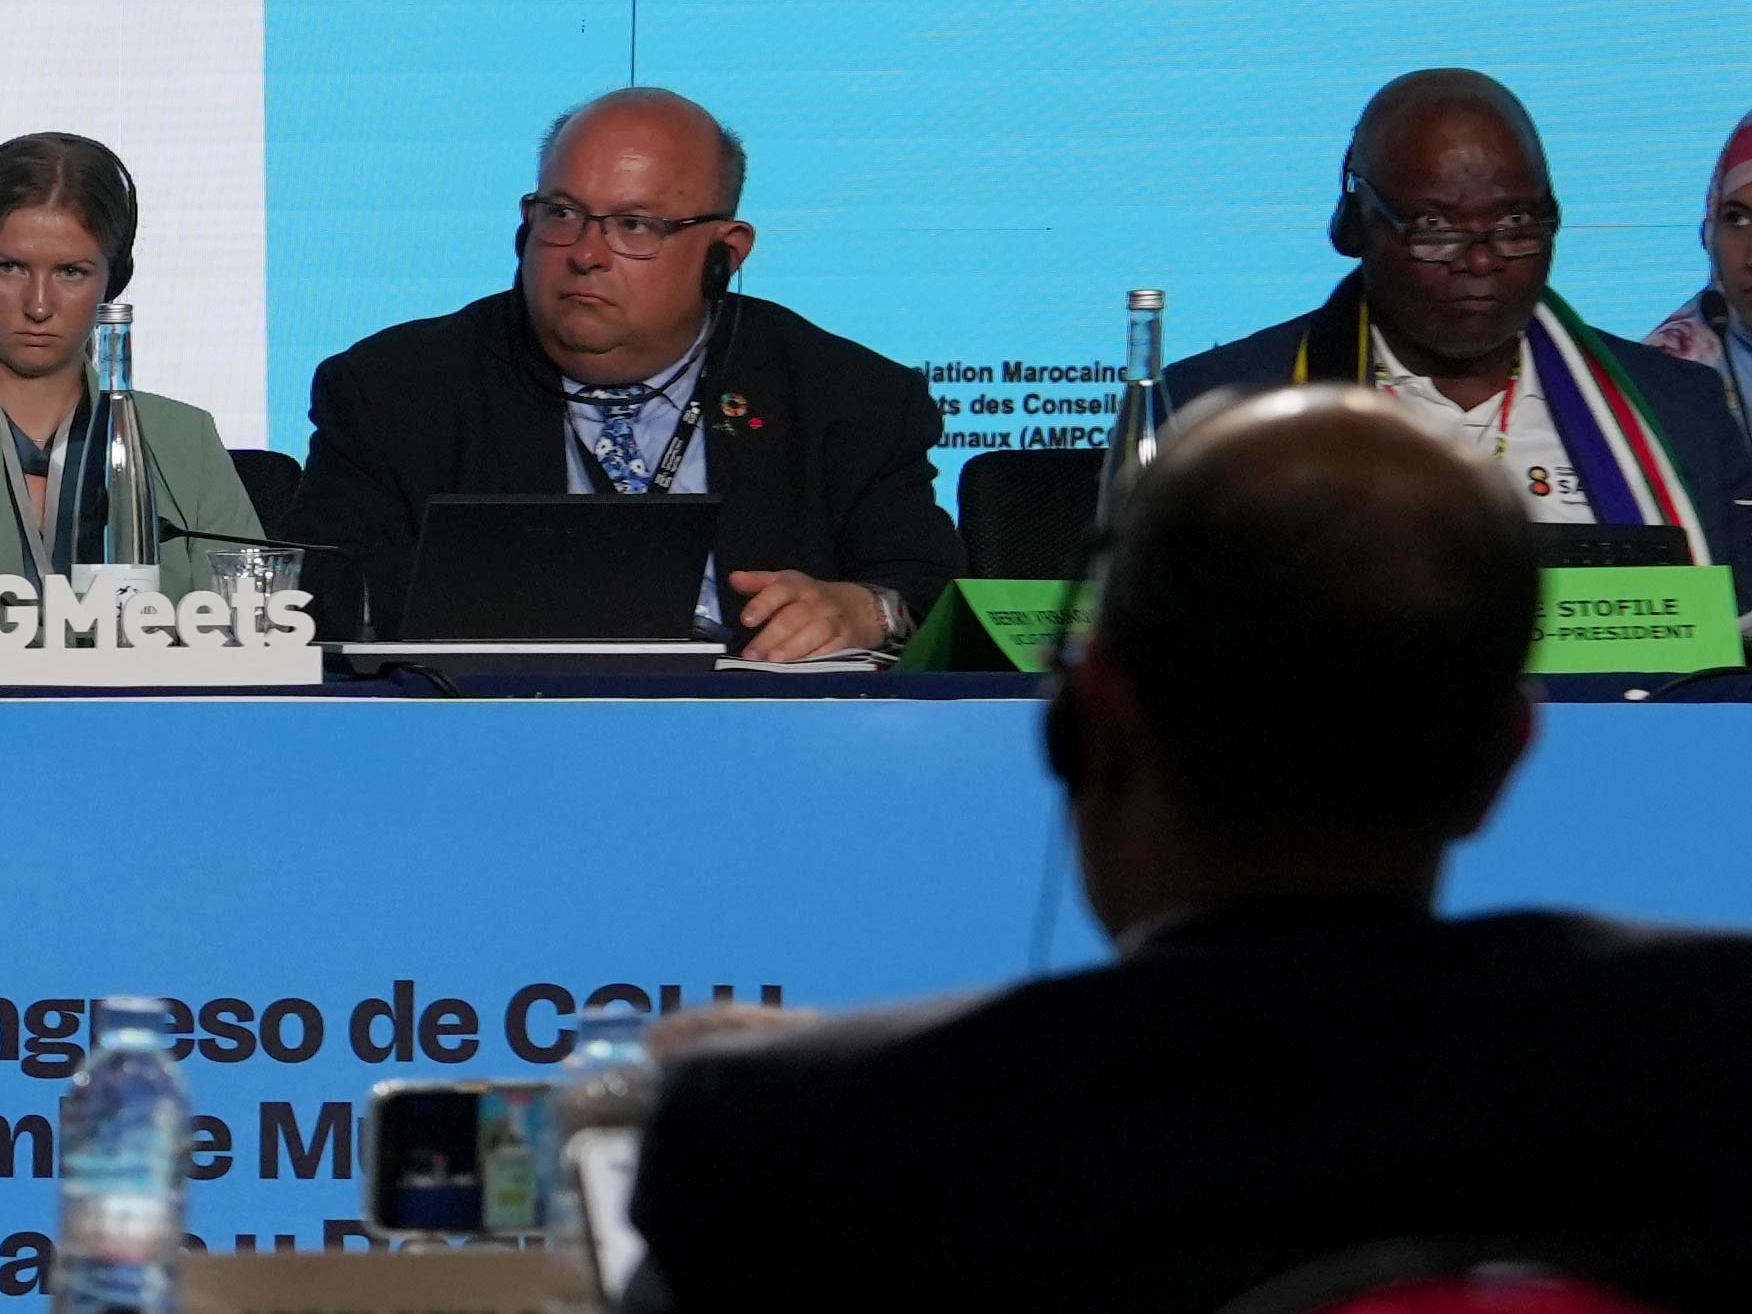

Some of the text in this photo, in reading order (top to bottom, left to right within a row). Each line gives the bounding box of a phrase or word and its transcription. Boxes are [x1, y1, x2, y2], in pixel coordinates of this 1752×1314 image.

[969, 393, 1015, 415] des
[1023, 393, 1117, 415] Conseil
[1019, 426, 1114, 450] (AMPC
[1557, 597, 1680, 618] STOFILE
[348, 979, 480, 1064] de
